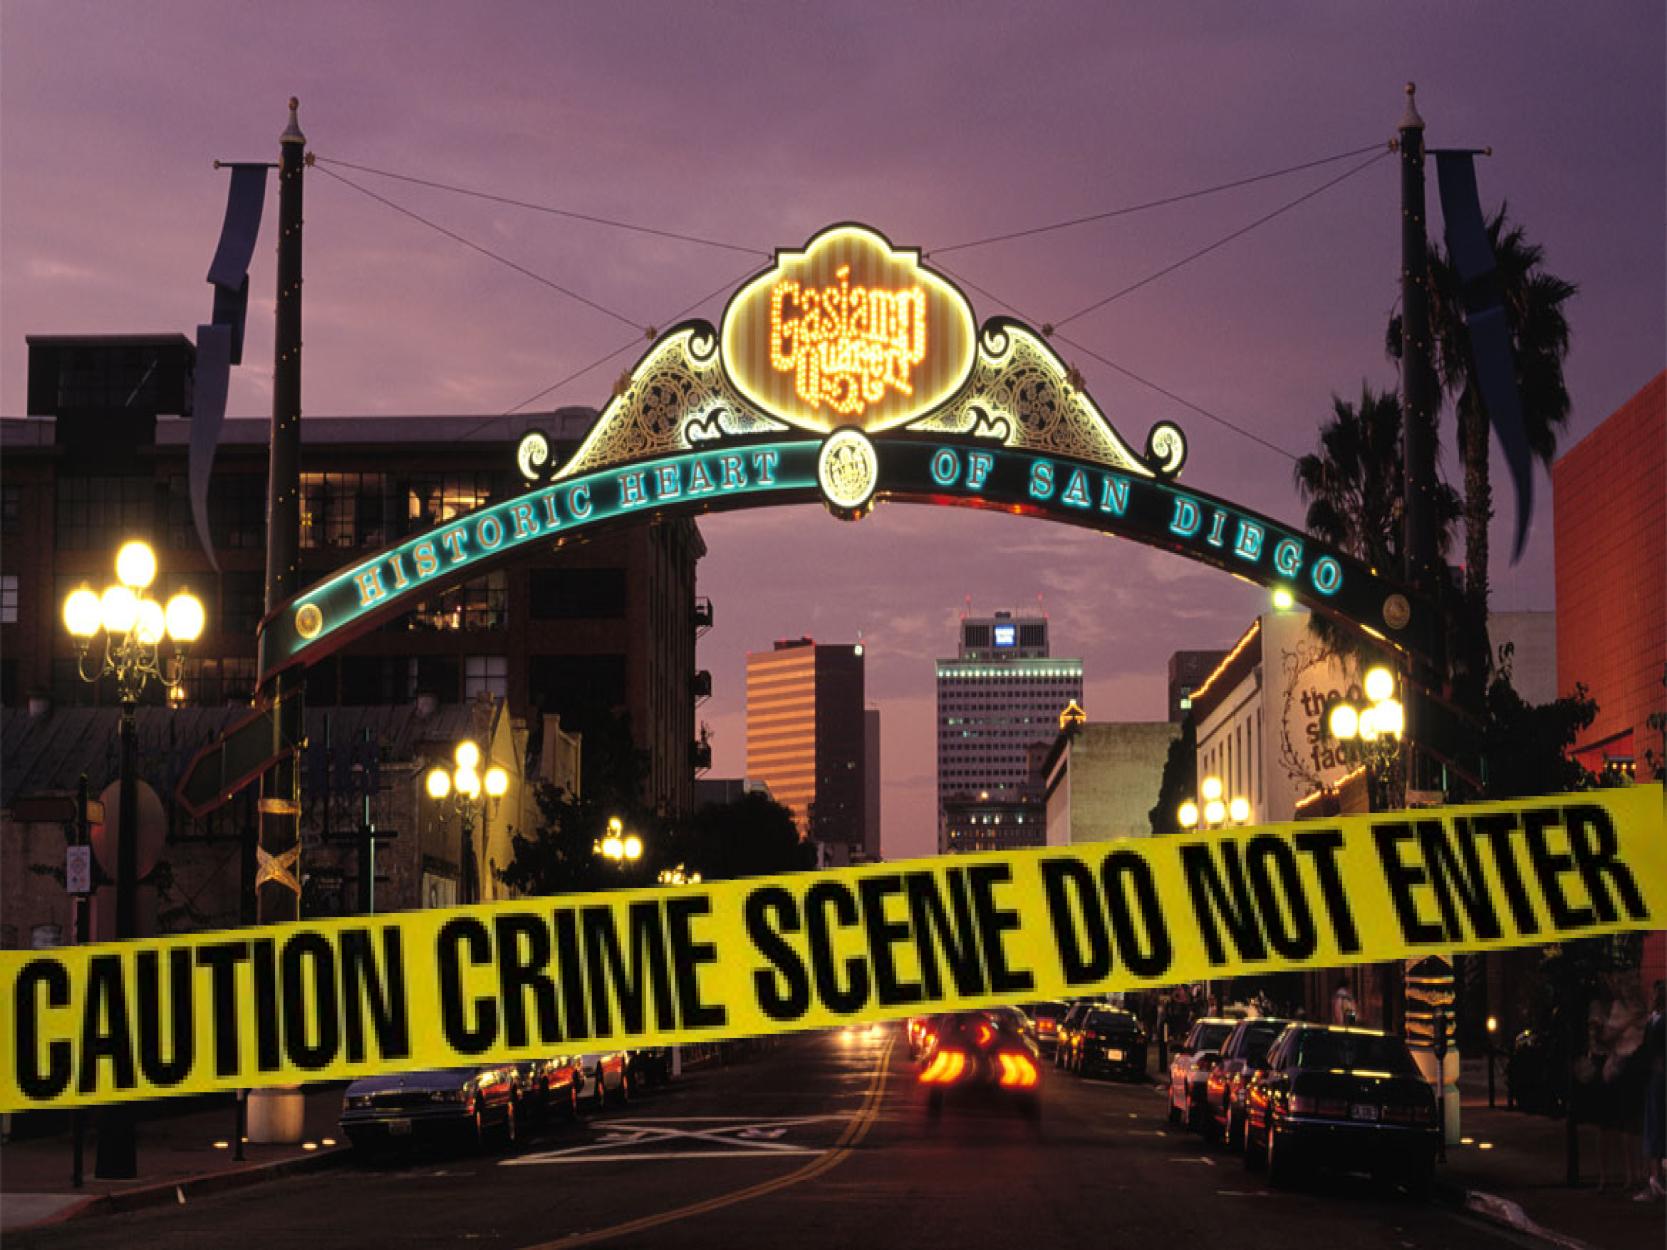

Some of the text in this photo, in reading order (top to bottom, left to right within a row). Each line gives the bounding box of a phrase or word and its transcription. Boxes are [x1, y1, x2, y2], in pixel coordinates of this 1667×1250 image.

[353, 448, 1343, 608] HISTORIC HEART OF SAN DIEGO
